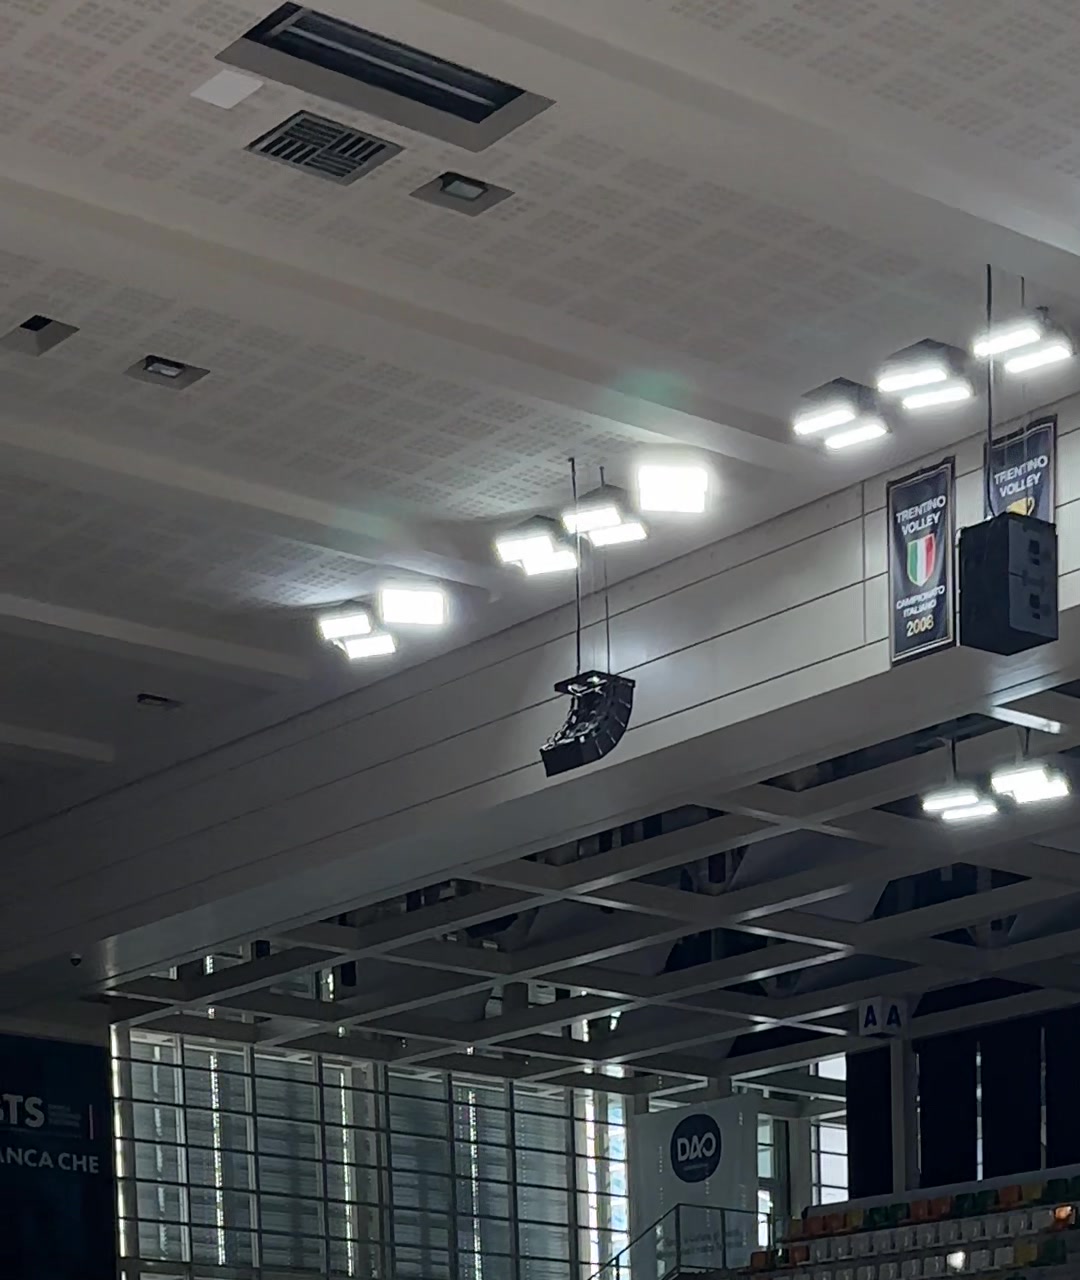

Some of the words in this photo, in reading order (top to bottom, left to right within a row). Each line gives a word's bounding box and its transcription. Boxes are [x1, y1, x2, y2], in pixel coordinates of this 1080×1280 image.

[994, 455, 1048, 485] TRENTINO
[1000, 472, 1041, 497] VOLLEY
[896, 495, 946, 524] TRENTINO
[902, 512, 942, 536] VOLLEY
[864, 1005, 877, 1028] A
[887, 1004, 901, 1027] A
[0, 1147, 54, 1168] NCA
[57, 1152, 99, 1173] CHE
